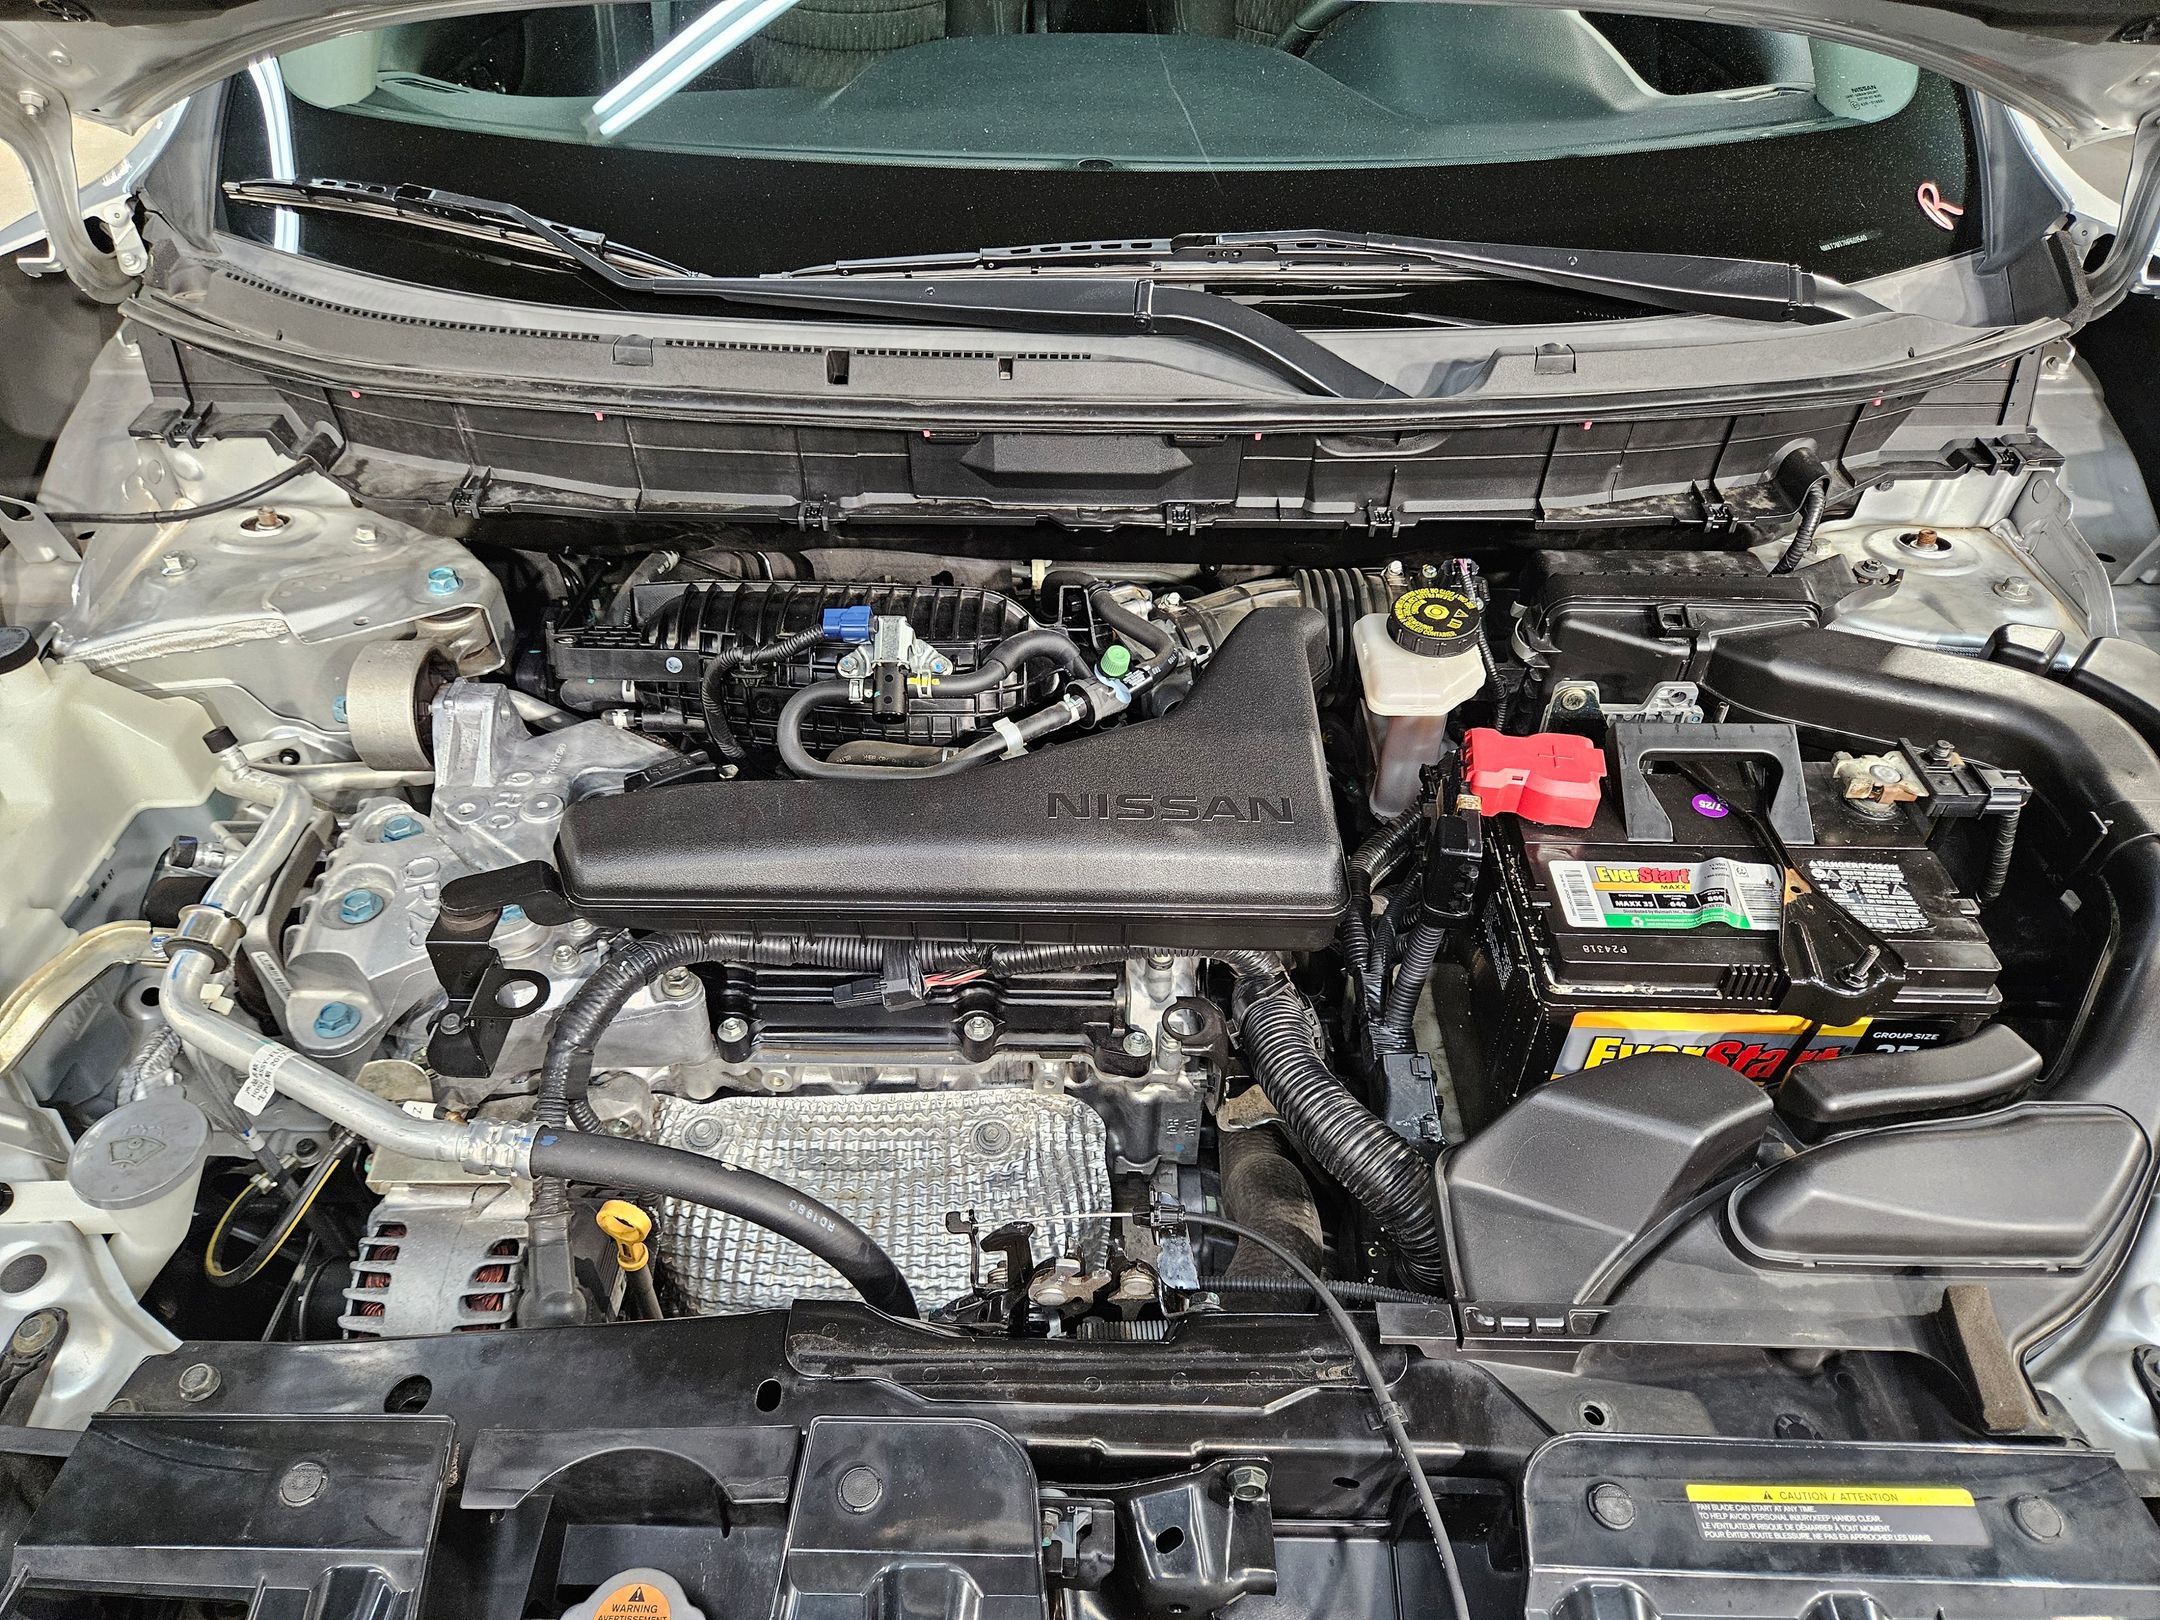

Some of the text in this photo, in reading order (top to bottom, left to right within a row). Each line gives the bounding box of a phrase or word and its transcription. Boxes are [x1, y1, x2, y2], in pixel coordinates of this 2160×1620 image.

[1047, 792, 1294, 824] NISSAN
[1698, 799, 1723, 812] 7/25
[1595, 865, 1690, 883] EverStart
[1872, 1031, 1914, 1040] GROUP
[1583, 1036, 1842, 1079] EvSta
[1779, 1491, 1828, 1501] CAUTION
[1840, 1492, 1899, 1502] ATTENTION
[1696, 1503, 1711, 1511] FAN
[1711, 1503, 1735, 1511] BLADE
[1751, 1504, 1773, 1512] START
[1799, 1505, 1817, 1513] TIME.
[1699, 1512, 1709, 1520] TO
[1710, 1512, 1728, 1520] HELP
[1750, 1513, 1789, 1521] PERSONAL
[1831, 1514, 1857, 1522] HANDS
[1702, 1522, 1711, 1530] LE
[1711, 1522, 1757, 1530] VENTILATEUR
[1757, 1523, 1784, 1531] RISQUE
[1785, 1523, 1795, 1531] DE
[1796, 1522, 1833, 1532] DÉMARRER
[1840, 1524, 1859, 1532] TOUT
[1704, 1530, 1725, 1539] POUR
[1726, 1529, 1750, 1539] ÉVITER
[1750, 1531, 1773, 1539] TOUTE
[1824, 1533, 1839, 1541] PAS
[1839, 1533, 1850, 1541] EN
[1850, 1533, 1894, 1541] APPROCHER
[1894, 1534, 1909, 1542] LES
[611, 1603, 658, 1613] WARNING
